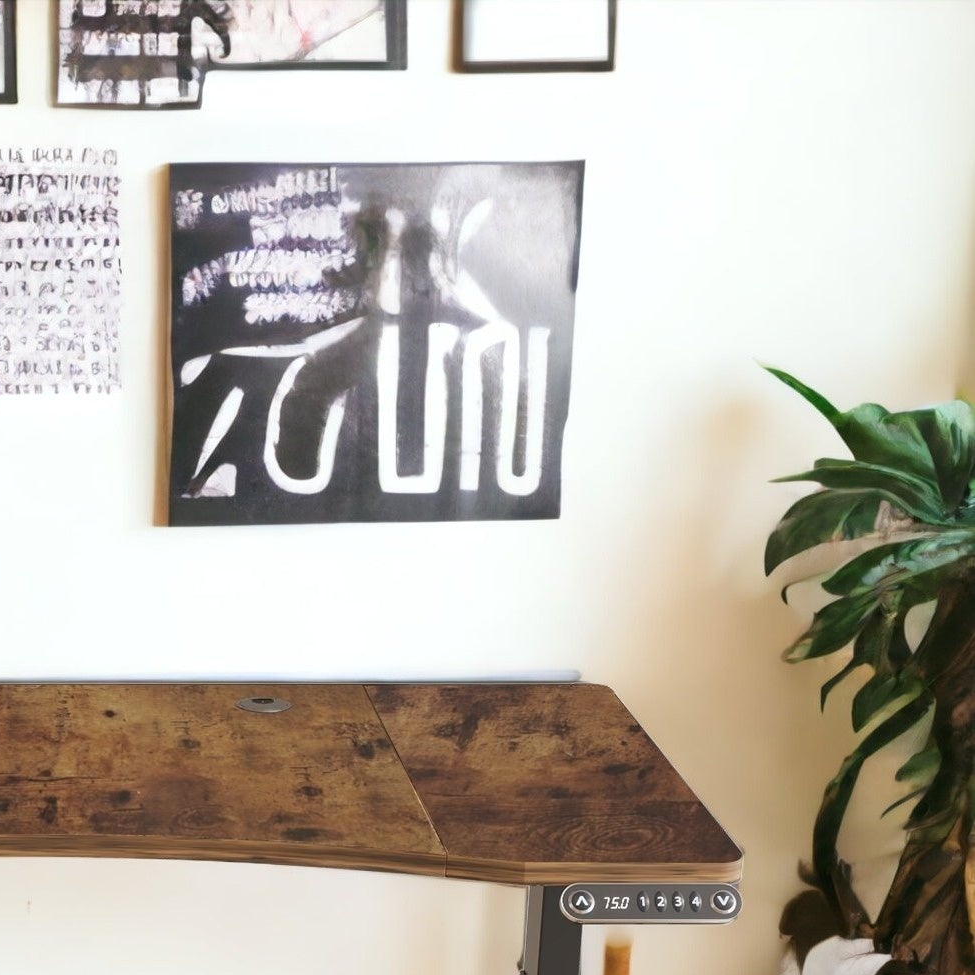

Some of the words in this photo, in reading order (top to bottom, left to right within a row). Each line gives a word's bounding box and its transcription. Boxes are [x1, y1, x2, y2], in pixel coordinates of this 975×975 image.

[603, 896, 630, 910] 75.0
[639, 896, 646, 907] 1
[656, 896, 665, 907] 2
[674, 896, 682, 907] 3
[691, 896, 700, 907] 4
